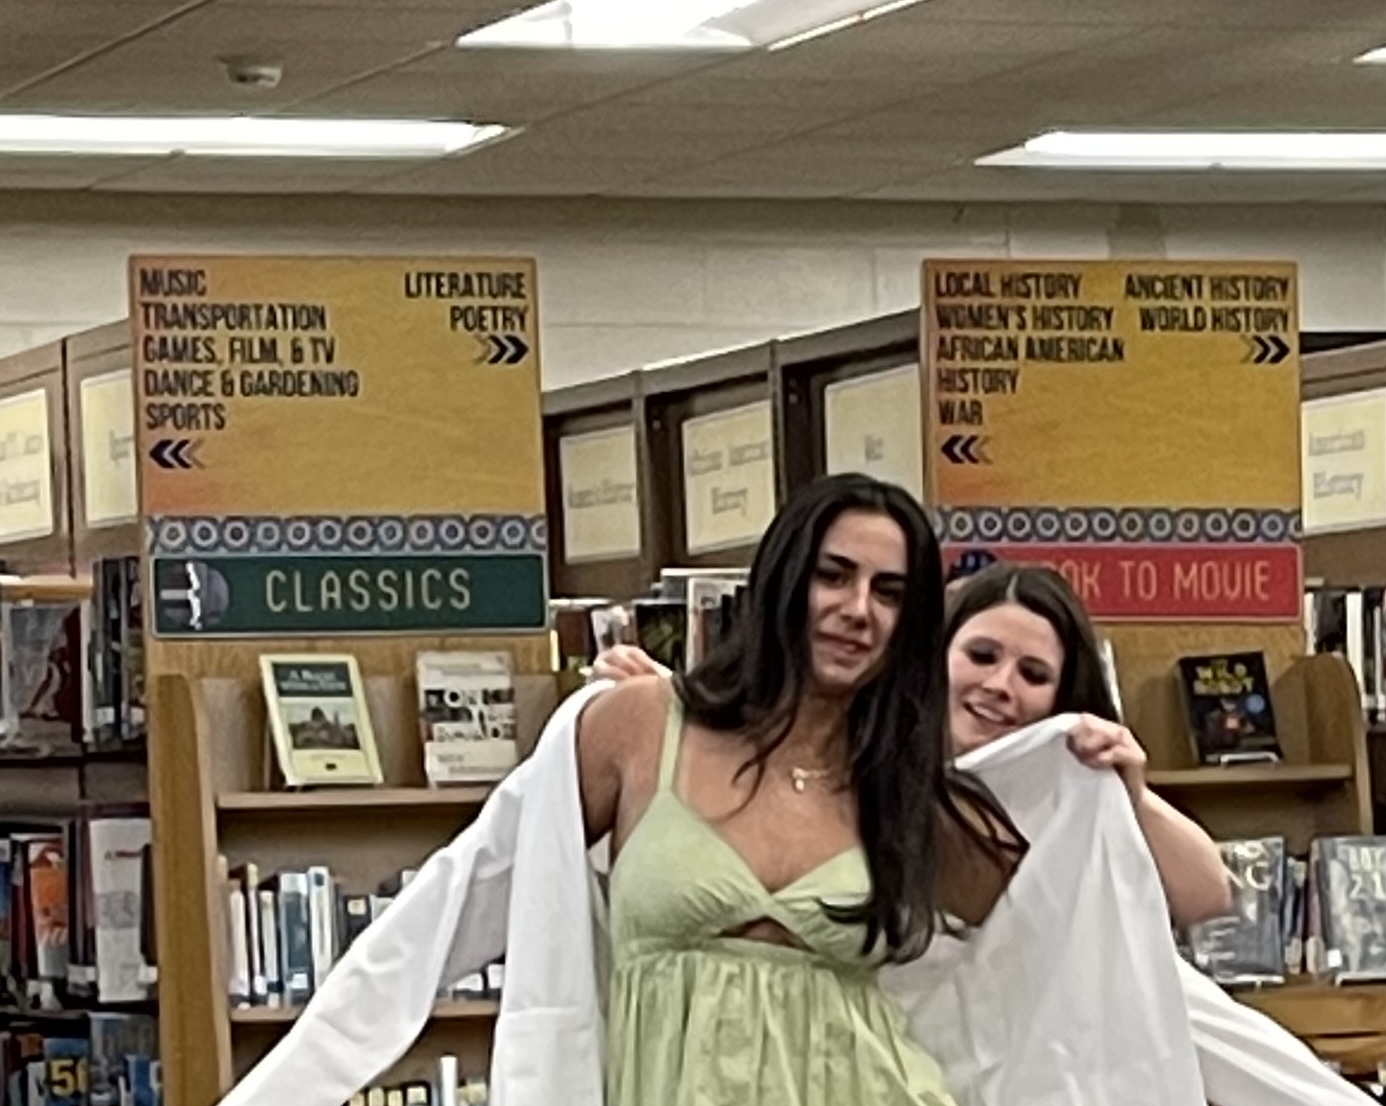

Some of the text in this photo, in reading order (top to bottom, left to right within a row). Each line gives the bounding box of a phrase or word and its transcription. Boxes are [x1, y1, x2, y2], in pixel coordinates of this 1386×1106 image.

[140, 268, 207, 296] MUSIC
[404, 272, 527, 299] LITERATURE
[934, 272, 1083, 298] LOCAL HISTORY
[1124, 274, 1290, 300] ANCIENT HISTORY
[141, 303, 327, 330] TRANSPORTATION
[450, 306, 529, 332] POETRY
[935, 304, 1114, 331] WOMEN'S HISTORY
[1139, 306, 1290, 333] WORLD HISTORY
[291, 337, 304, 364] &
[309, 336, 335, 364] TV
[936, 335, 1125, 363] AFRICAN AMERICAN
[144, 369, 359, 397] DANCE & GARDENING
[936, 367, 1020, 394] HISTORY
[146, 402, 226, 430] SPORTS
[938, 399, 984, 426] WAR
[265, 568, 472, 613] CLASSICS
[1118, 560, 1158, 600] TO
[1172, 560, 1270, 600] MOVIE
